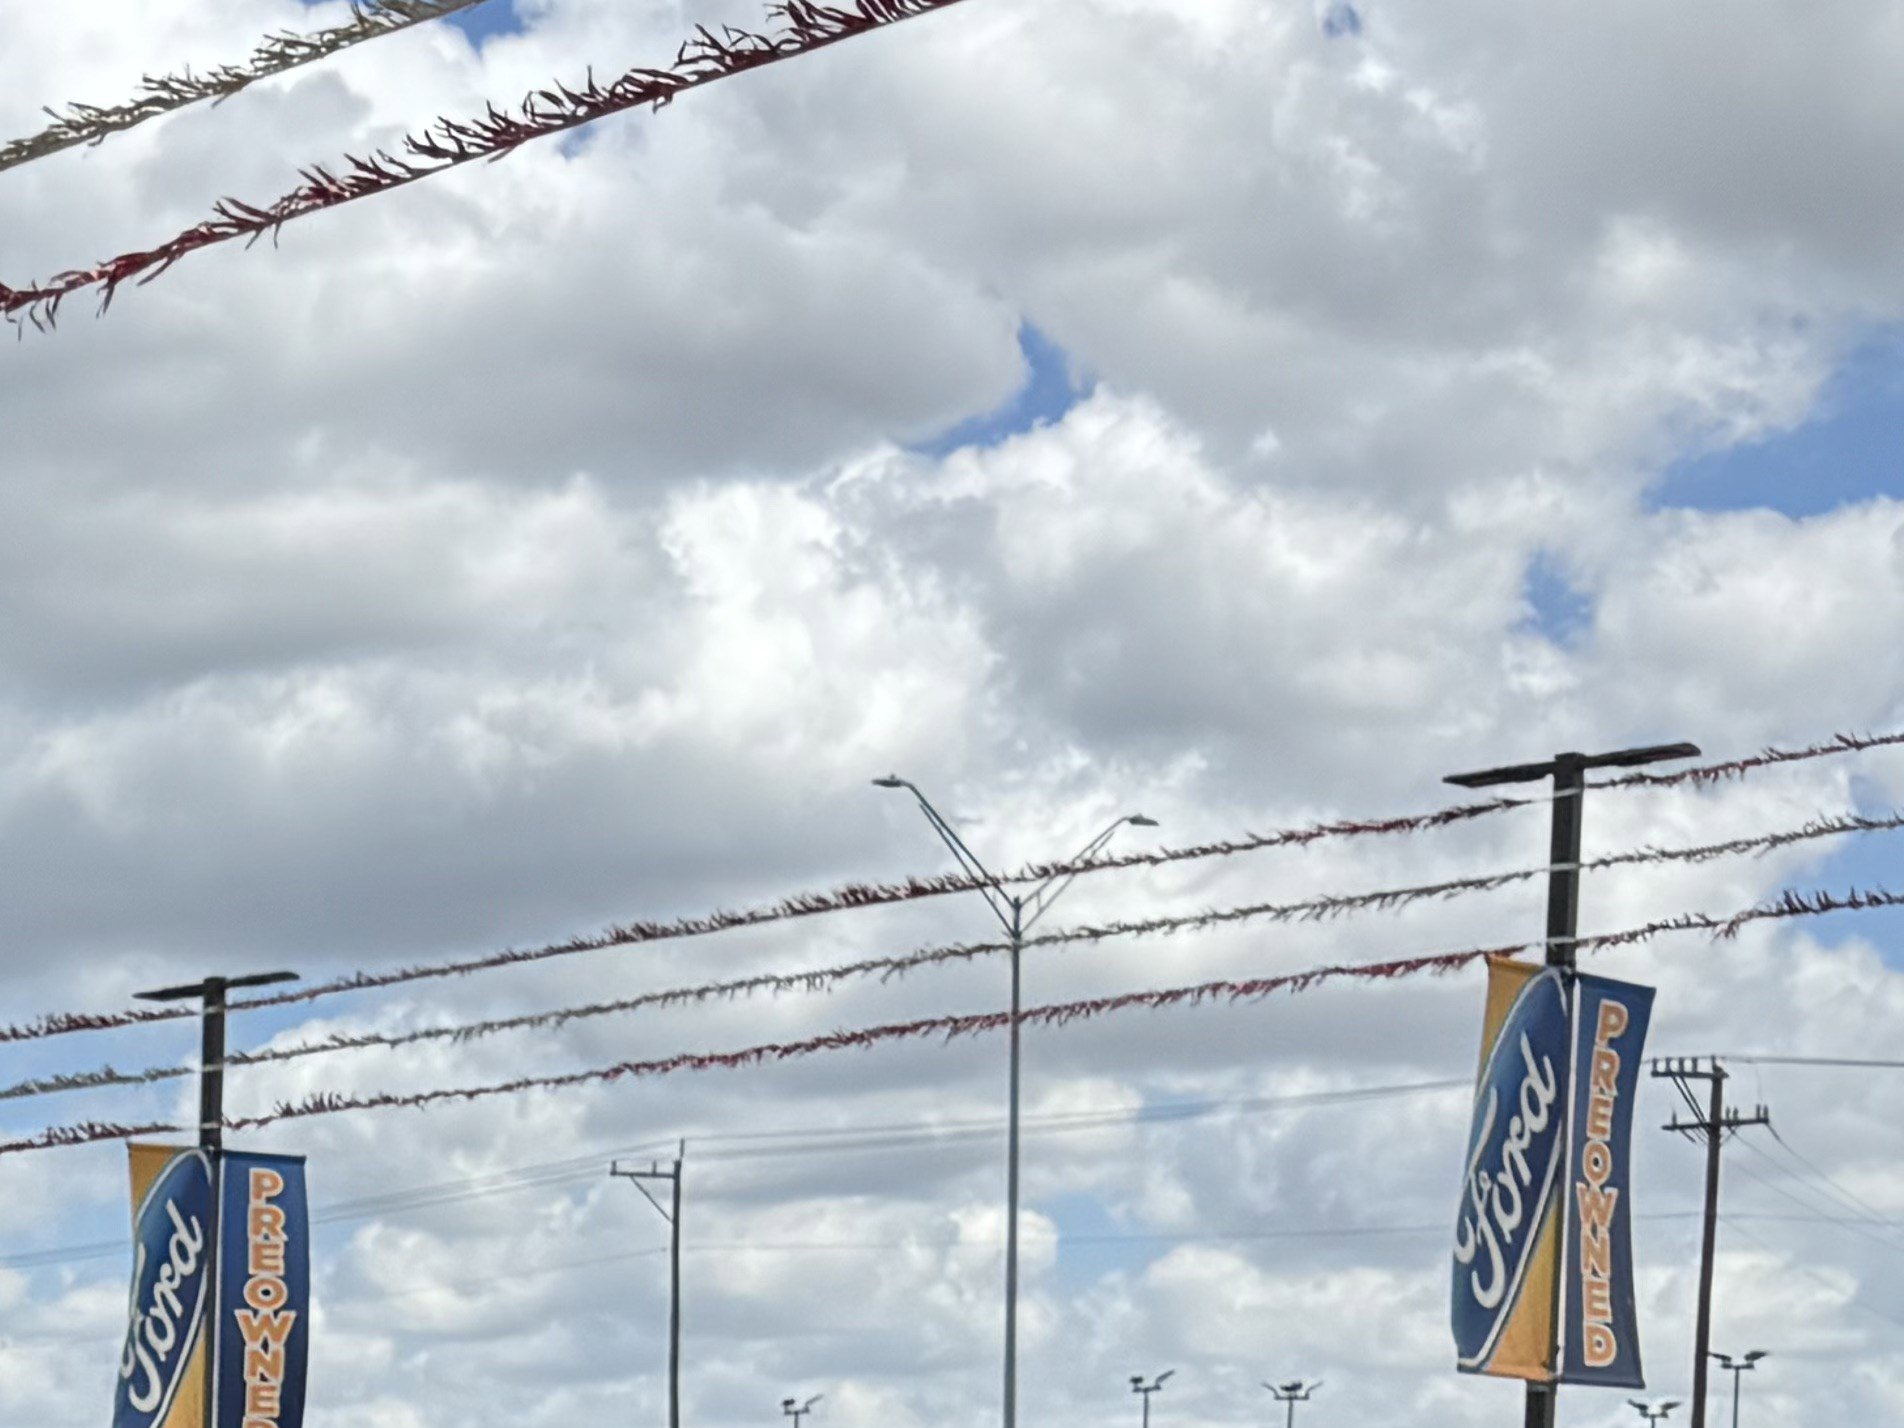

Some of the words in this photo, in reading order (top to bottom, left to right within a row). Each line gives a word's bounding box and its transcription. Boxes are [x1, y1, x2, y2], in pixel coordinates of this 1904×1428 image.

[120, 1197, 204, 1413] Ford
[1453, 1028, 1558, 1310] Ford
[1575, 999, 1628, 1368] PREOWNED
